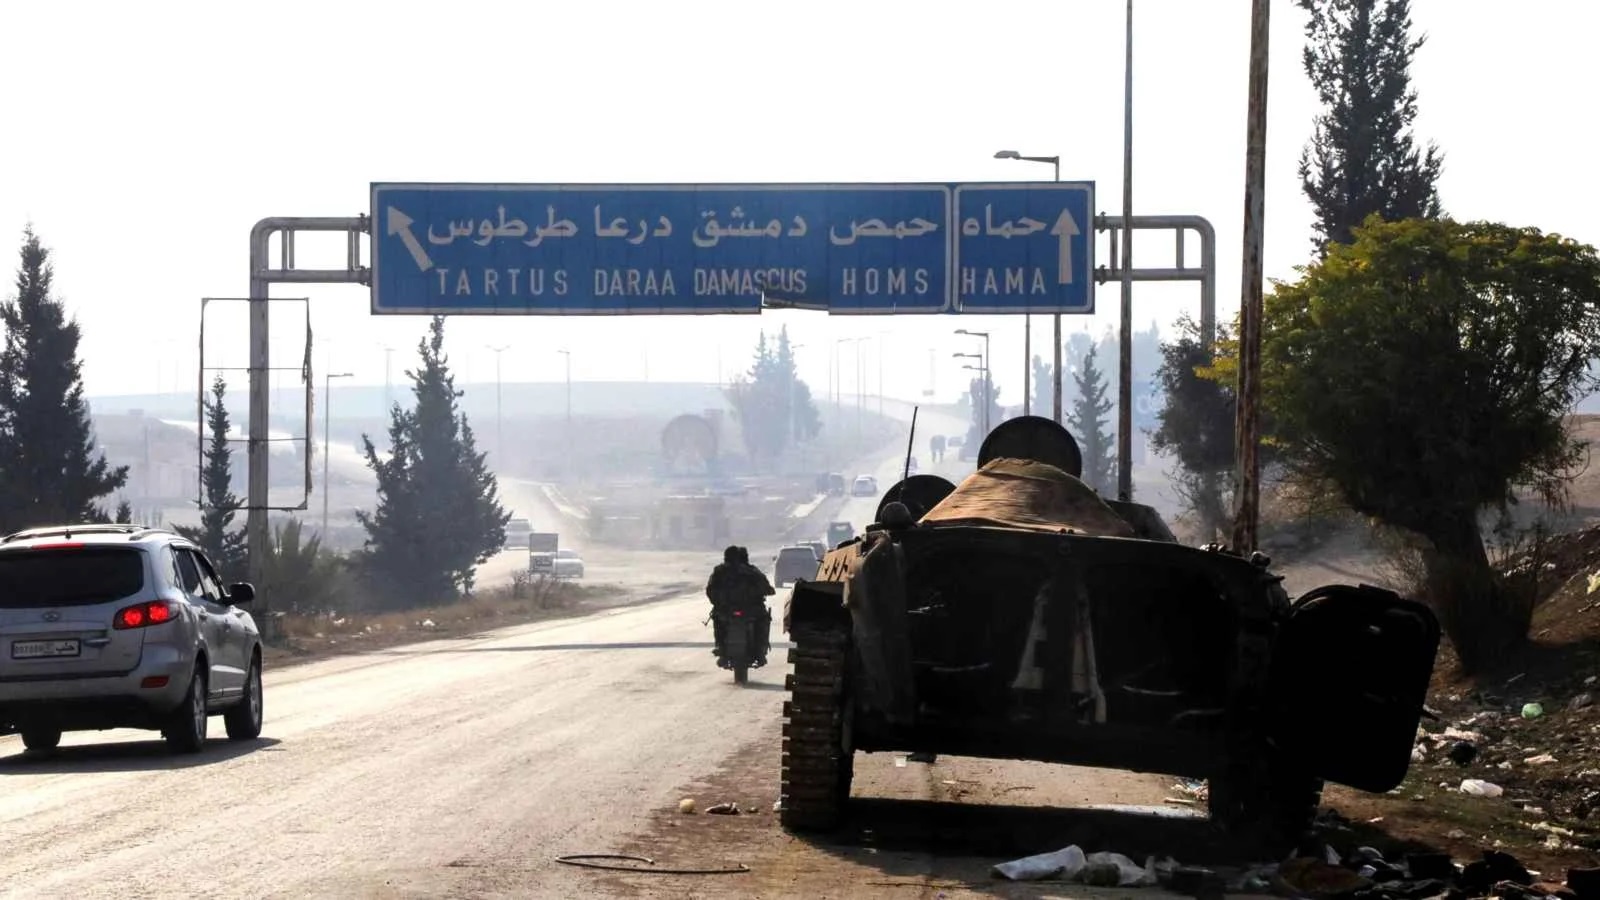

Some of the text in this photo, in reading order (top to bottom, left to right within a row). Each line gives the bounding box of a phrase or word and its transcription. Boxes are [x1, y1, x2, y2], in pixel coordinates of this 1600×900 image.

[428, 205, 937, 247] حمص دمشق درعا طرطوس
[437, 268, 928, 296] TARTUS DARAA DAMASCUS HOMS
[963, 268, 1045, 294] HAMA
